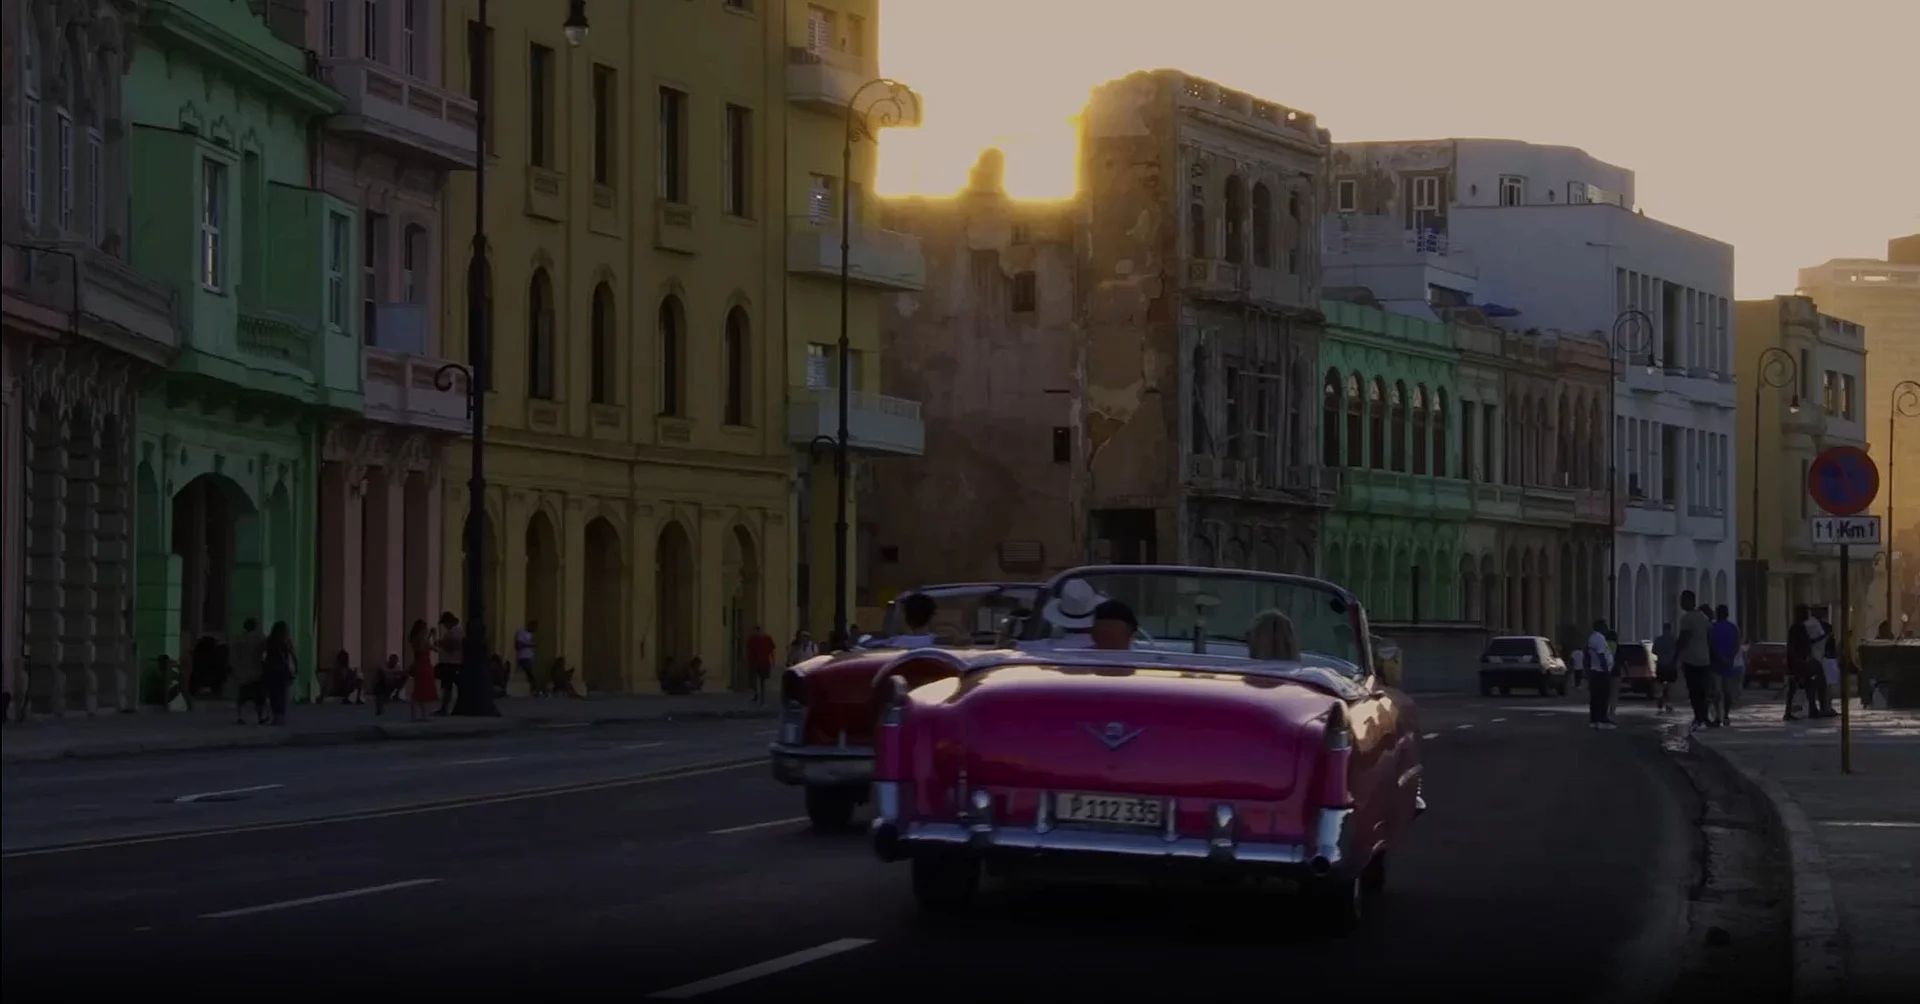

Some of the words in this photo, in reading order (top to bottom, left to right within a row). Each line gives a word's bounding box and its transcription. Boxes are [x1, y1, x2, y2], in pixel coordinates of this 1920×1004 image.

[1826, 520, 1833, 539] 1
[1839, 520, 1865, 538] Km
[1086, 799, 1120, 821] 112
